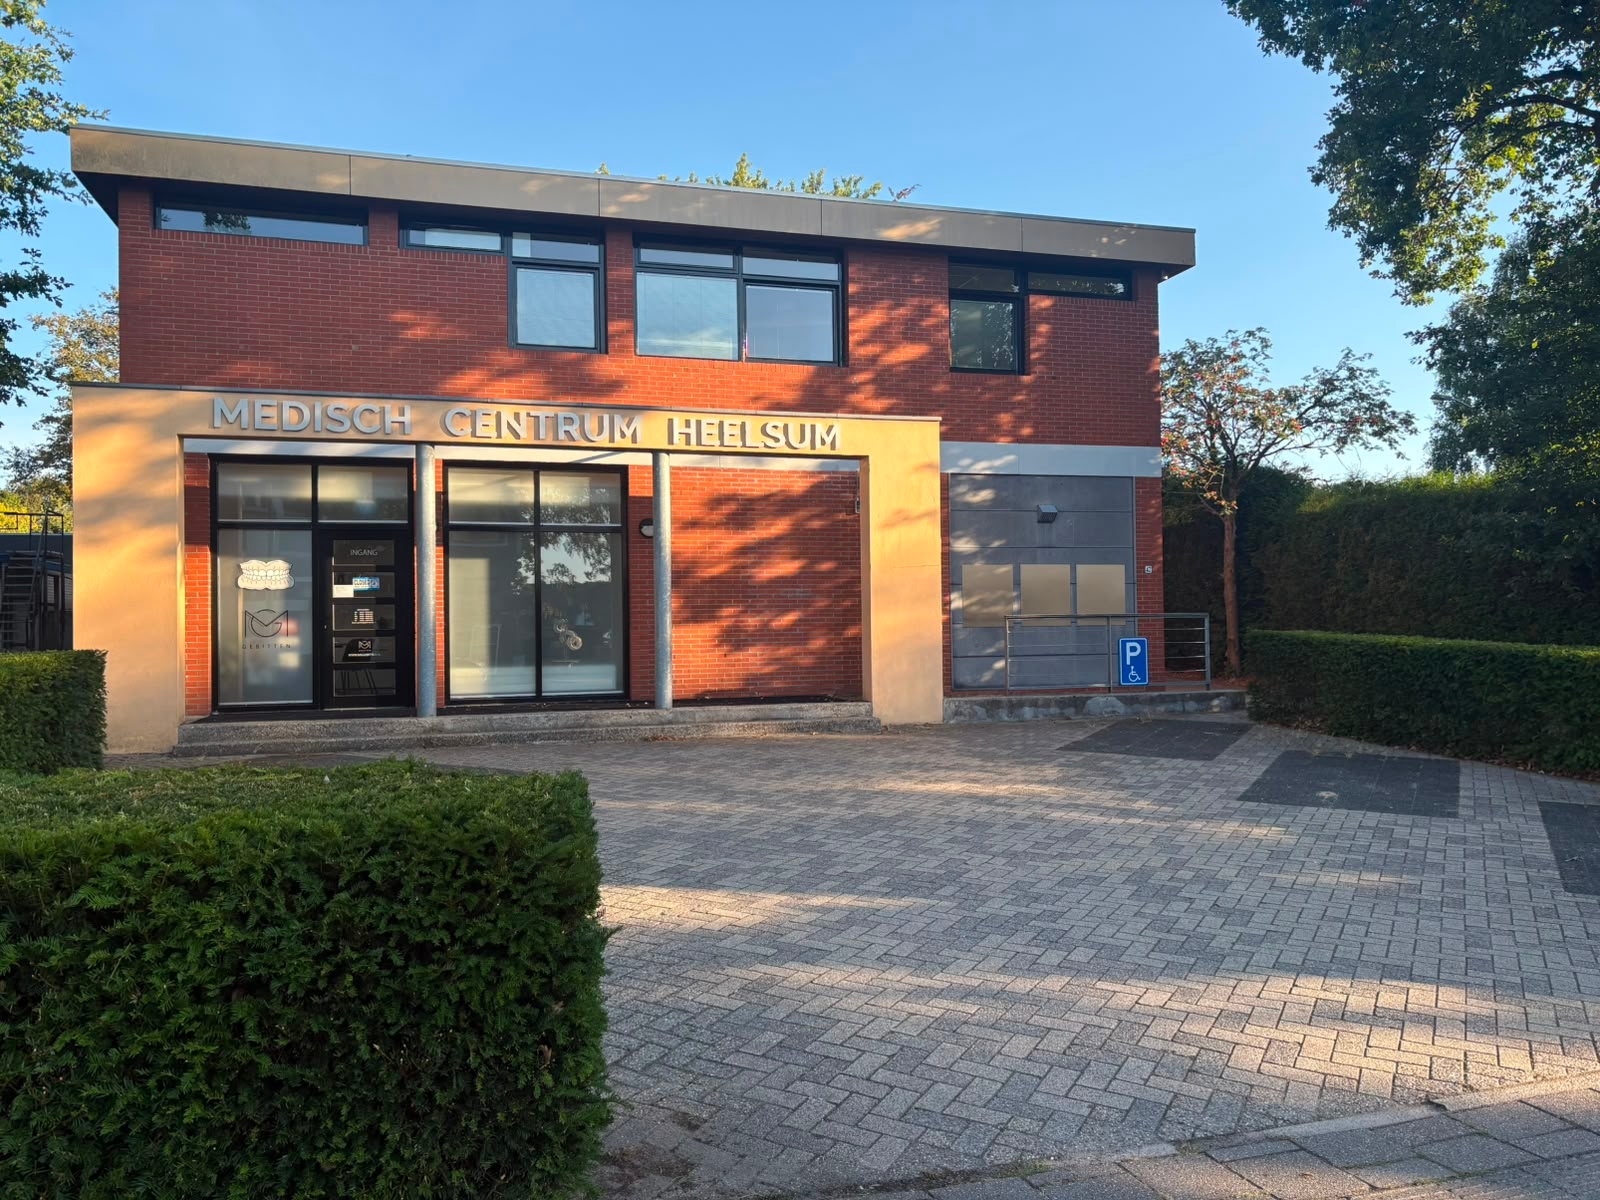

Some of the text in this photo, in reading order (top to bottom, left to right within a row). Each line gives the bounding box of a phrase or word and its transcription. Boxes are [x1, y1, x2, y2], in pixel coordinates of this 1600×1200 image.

[213, 397, 841, 451] MEDISCH CENTRUM HEELSUM
[1126, 642, 1141, 665] P
